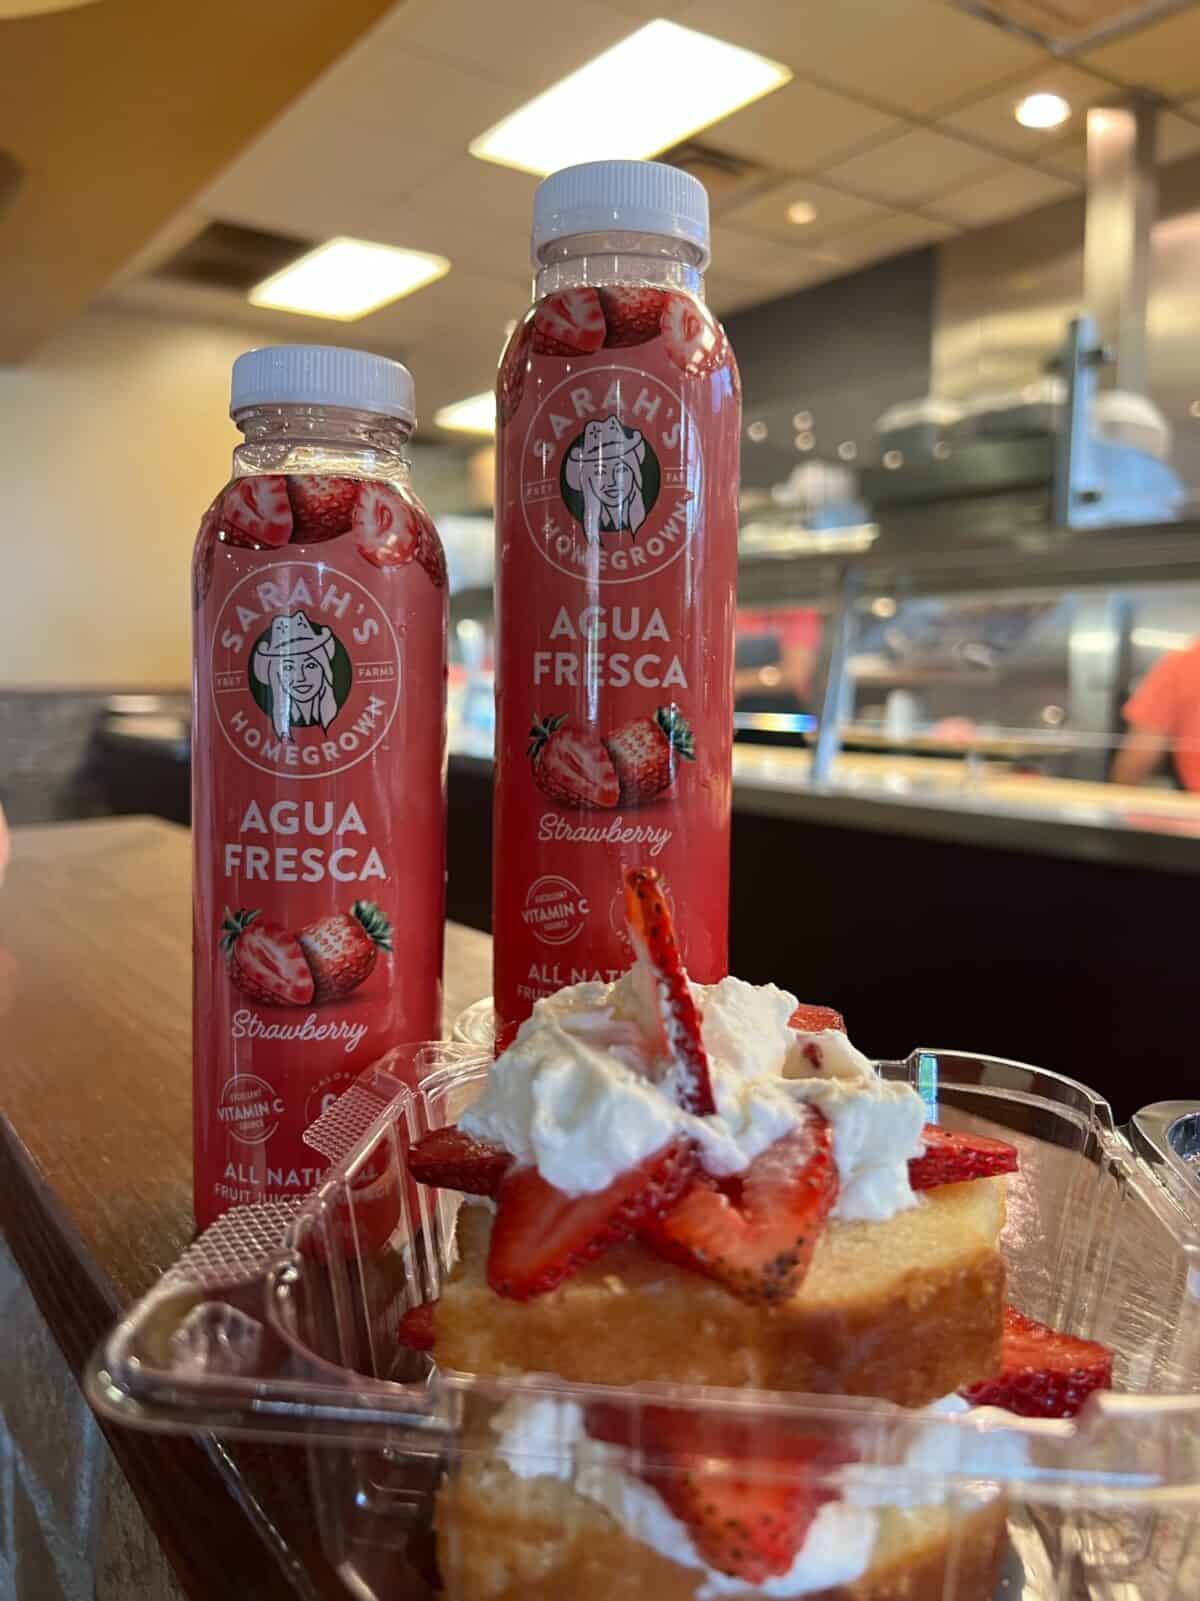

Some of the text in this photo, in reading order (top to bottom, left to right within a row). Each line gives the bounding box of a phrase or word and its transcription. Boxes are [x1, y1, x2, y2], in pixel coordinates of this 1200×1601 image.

[533, 383, 683, 461] SARAH'S
[221, 577, 379, 653] SARAH'S
[549, 606, 671, 641] AGUA
[533, 652, 688, 688] FRESCA
[231, 695, 387, 766] HOMEGROWN
[240, 800, 367, 835] AGUA
[537, 813, 673, 857] Strawberry
[225, 844, 387, 882] FRESCA
[521, 899, 591, 925] VITAMIN C
[527, 963, 564, 984] ALL
[231, 1009, 368, 1052] Strawberry
[216, 1098, 285, 1120] VITAMIN C
[224, 1161, 259, 1185] ALL
[214, 1183, 250, 1202] FRUIT
